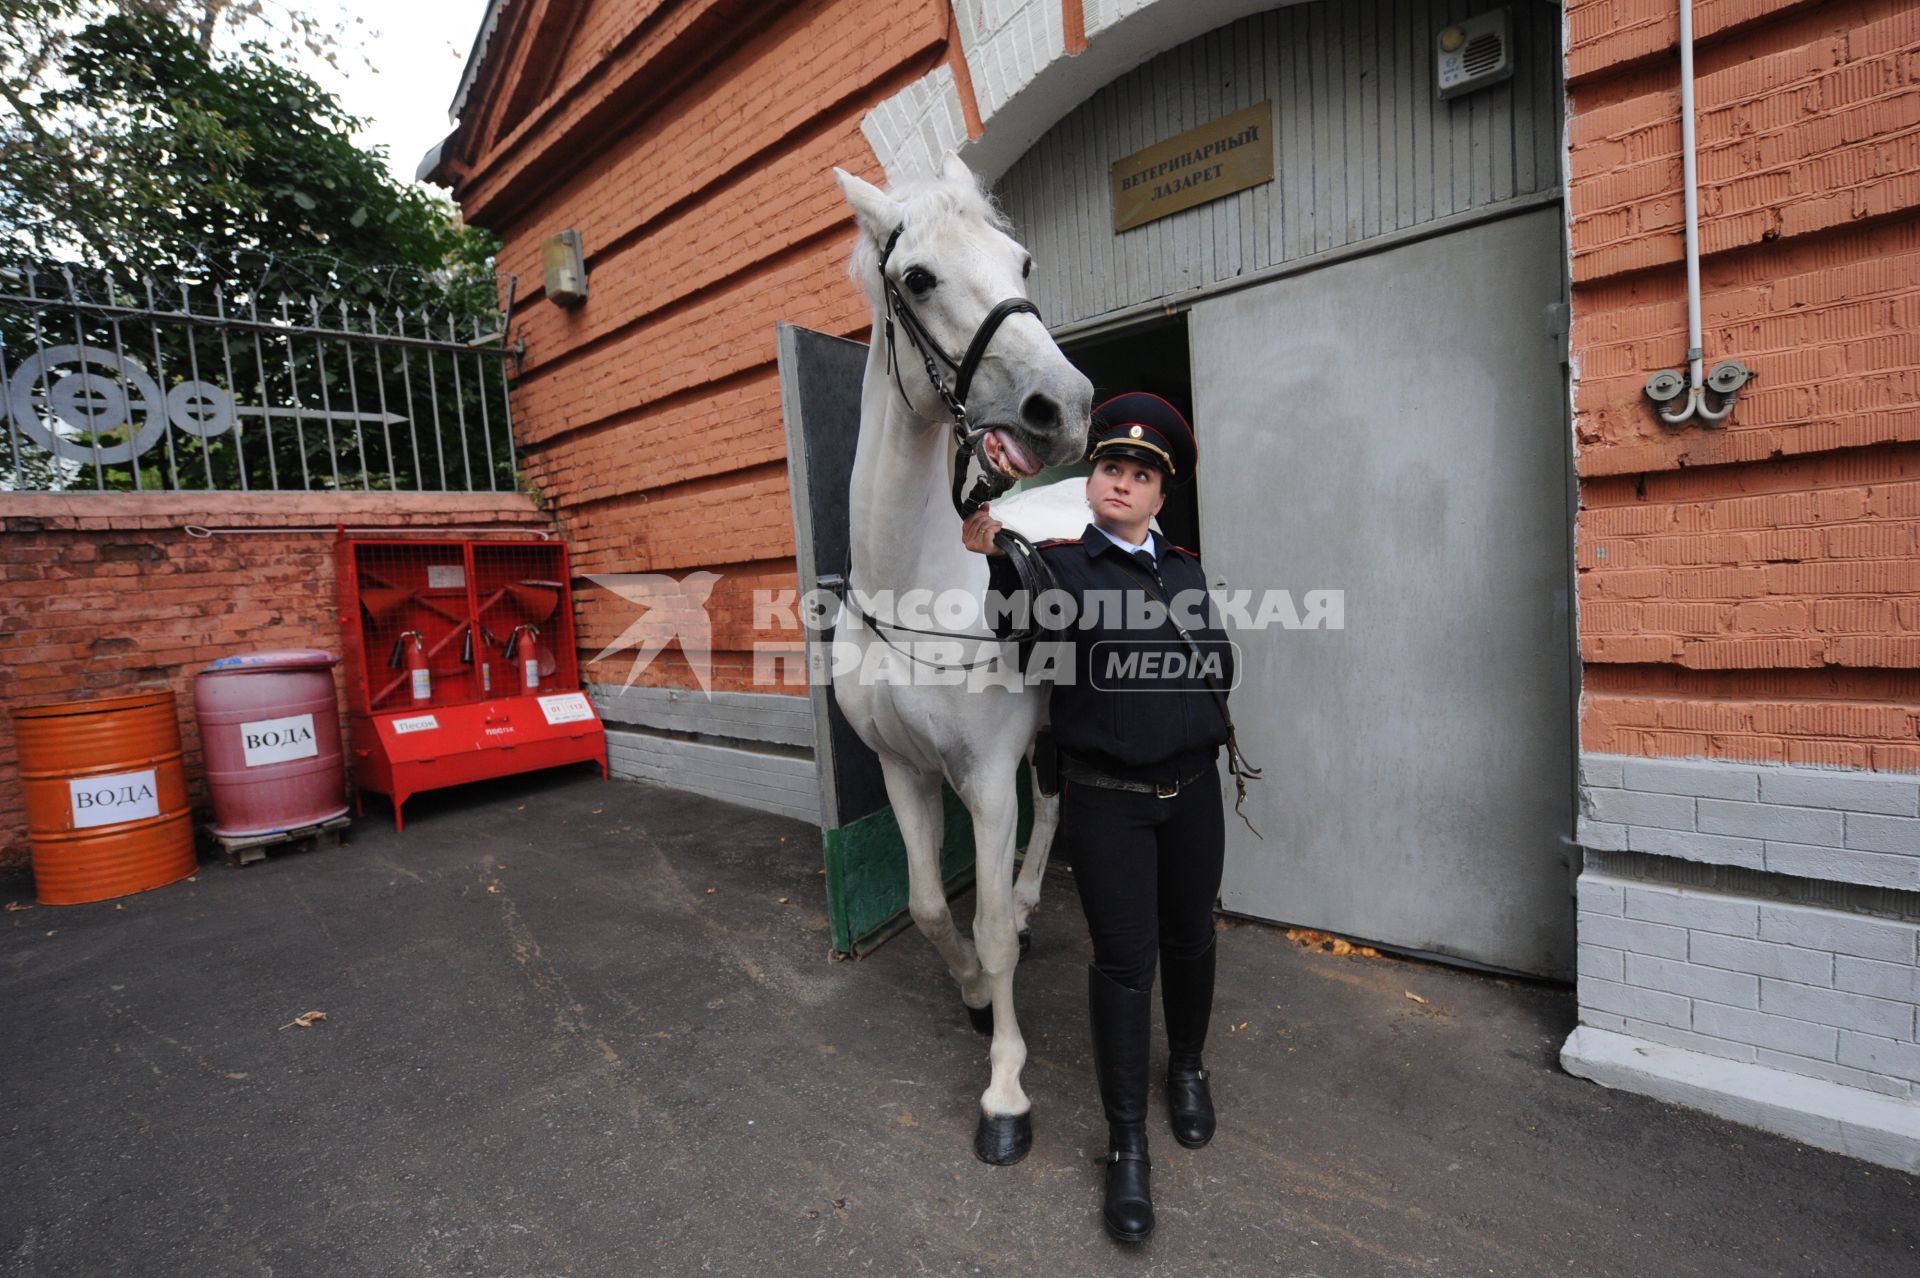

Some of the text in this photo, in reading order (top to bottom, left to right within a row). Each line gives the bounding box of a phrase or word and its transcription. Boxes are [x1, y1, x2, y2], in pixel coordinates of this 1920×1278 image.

[1121, 125, 1260, 191] ВЕТЕРИНАРНЫЙ
[1151, 163, 1223, 201] ЛАЗАРЕТ
[246, 726, 313, 750] ВОДА
[76, 783, 154, 809] ВОДА
